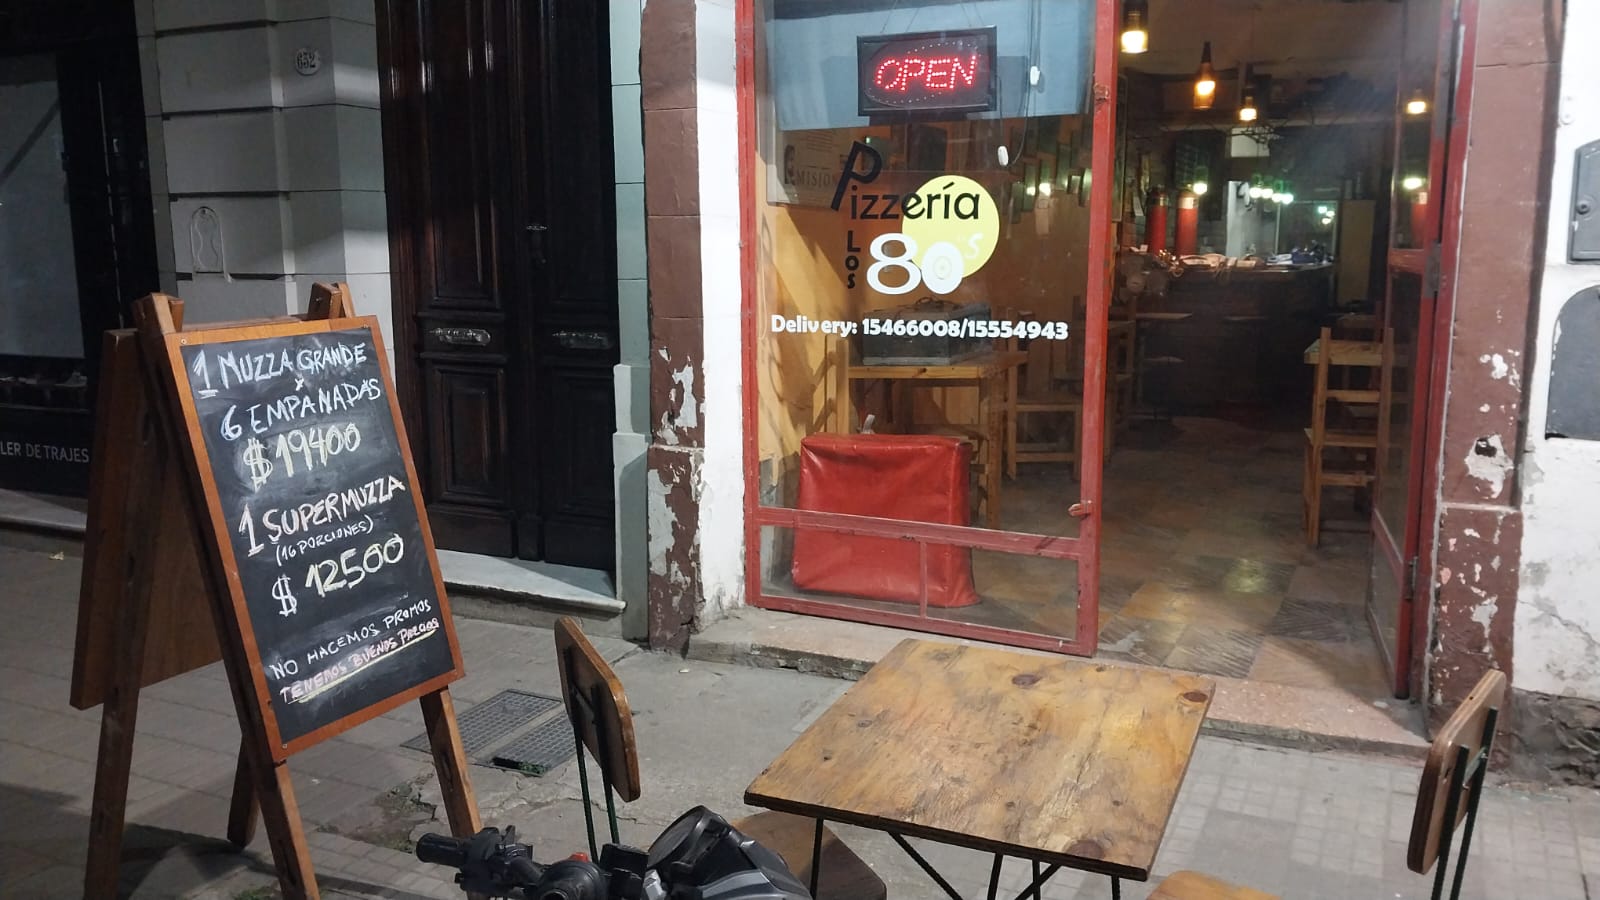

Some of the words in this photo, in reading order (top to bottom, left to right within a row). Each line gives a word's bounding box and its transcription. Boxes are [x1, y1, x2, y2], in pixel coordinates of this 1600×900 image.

[876, 55, 978, 91] OPEN
[831, 140, 981, 220] Pizzería
[771, 314, 858, 338] Delivery:
[862, 318, 1069, 341] 15466008/15554943
[193, 349, 219, 398] 1
[217, 348, 294, 389] MUZZA
[296, 342, 367, 375] GRANDE
[220, 405, 242, 441] 6
[246, 378, 381, 434] EMPANADAS
[25, 443, 42, 459] DE
[42, 445, 90, 463] TRAJES
[238, 503, 264, 557] 1
[262, 475, 405, 544] SUPERMUZZA
[297, 514, 374, 555] PORCIONES)
[270, 659, 299, 681] NO
[307, 623, 381, 665] HACEMOS
[383, 599, 432, 630] PROMOS
[279, 663, 348, 703] TENEMOS
[349, 637, 399, 667] BUENOS
